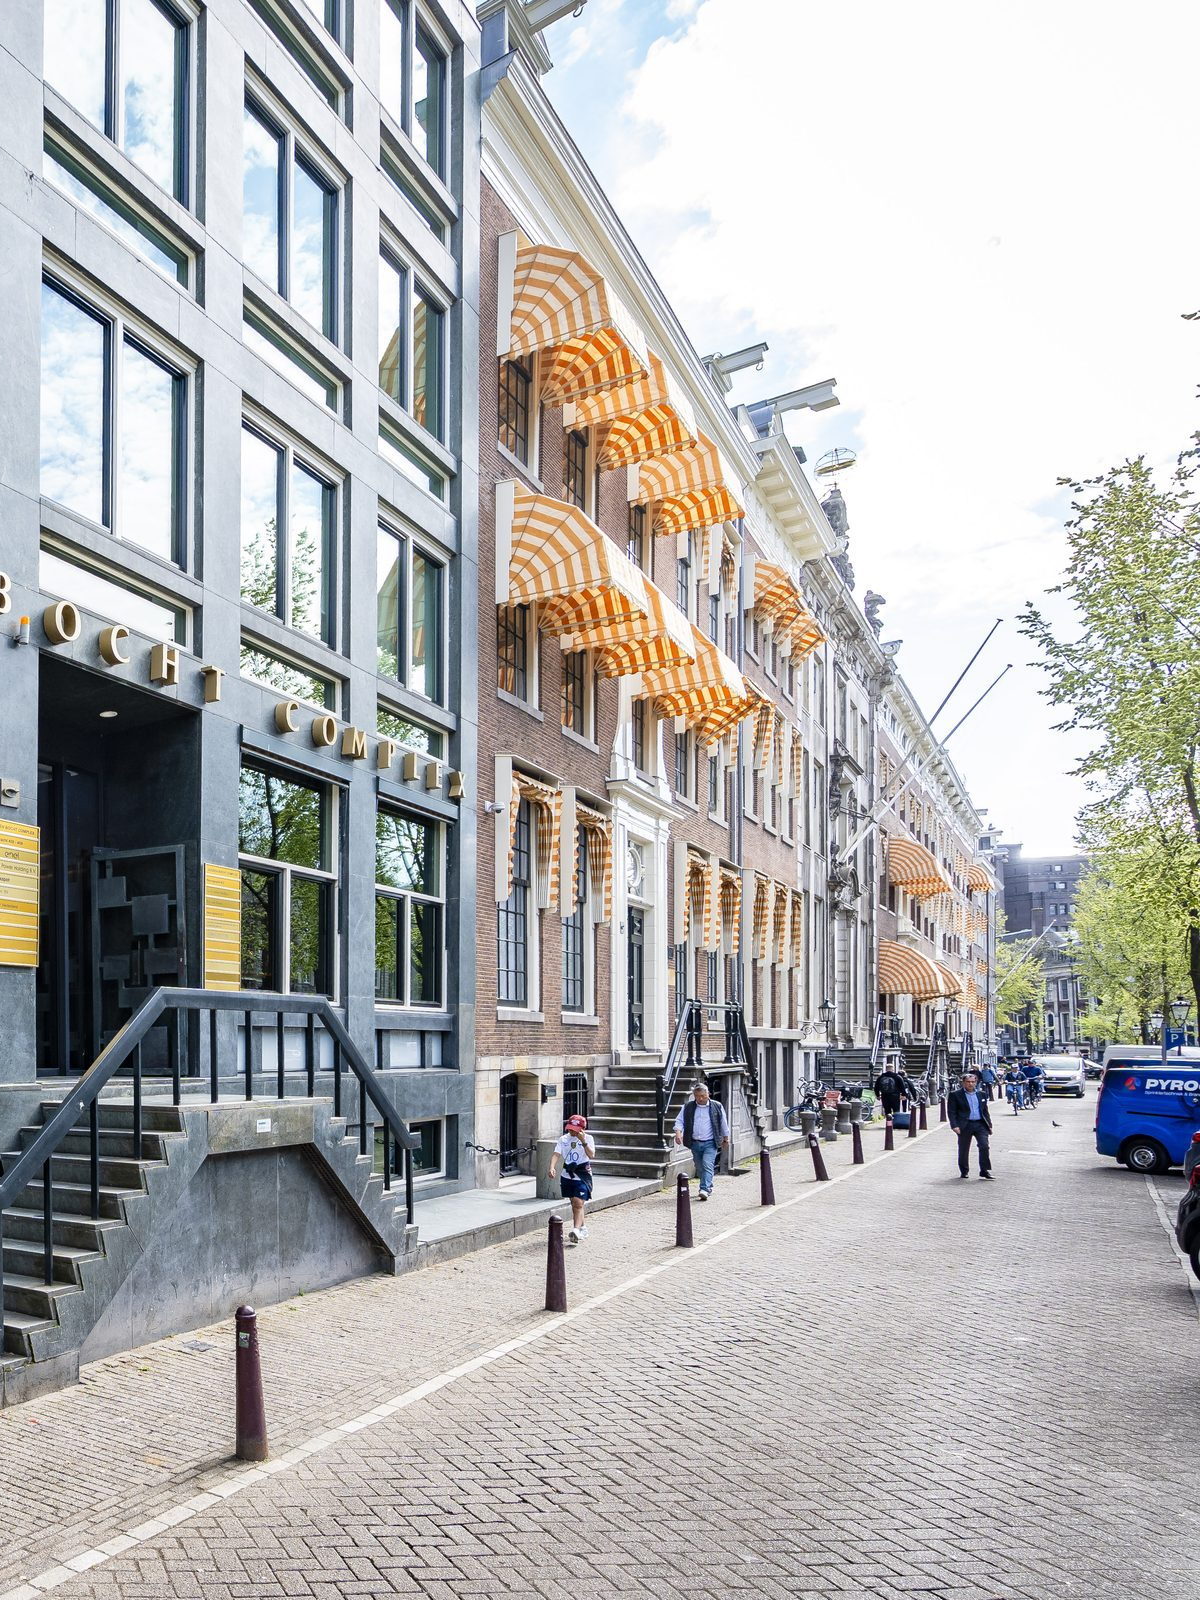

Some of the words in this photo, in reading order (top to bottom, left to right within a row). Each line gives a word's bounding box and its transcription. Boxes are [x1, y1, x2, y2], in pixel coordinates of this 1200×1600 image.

[274, 700, 467, 799] COMPLEX
[4, 851, 19, 860] enel
[1171, 1033, 1179, 1043] P
[1145, 1078, 1200, 1091] PYRO
[569, 1152, 579, 1162] 10
